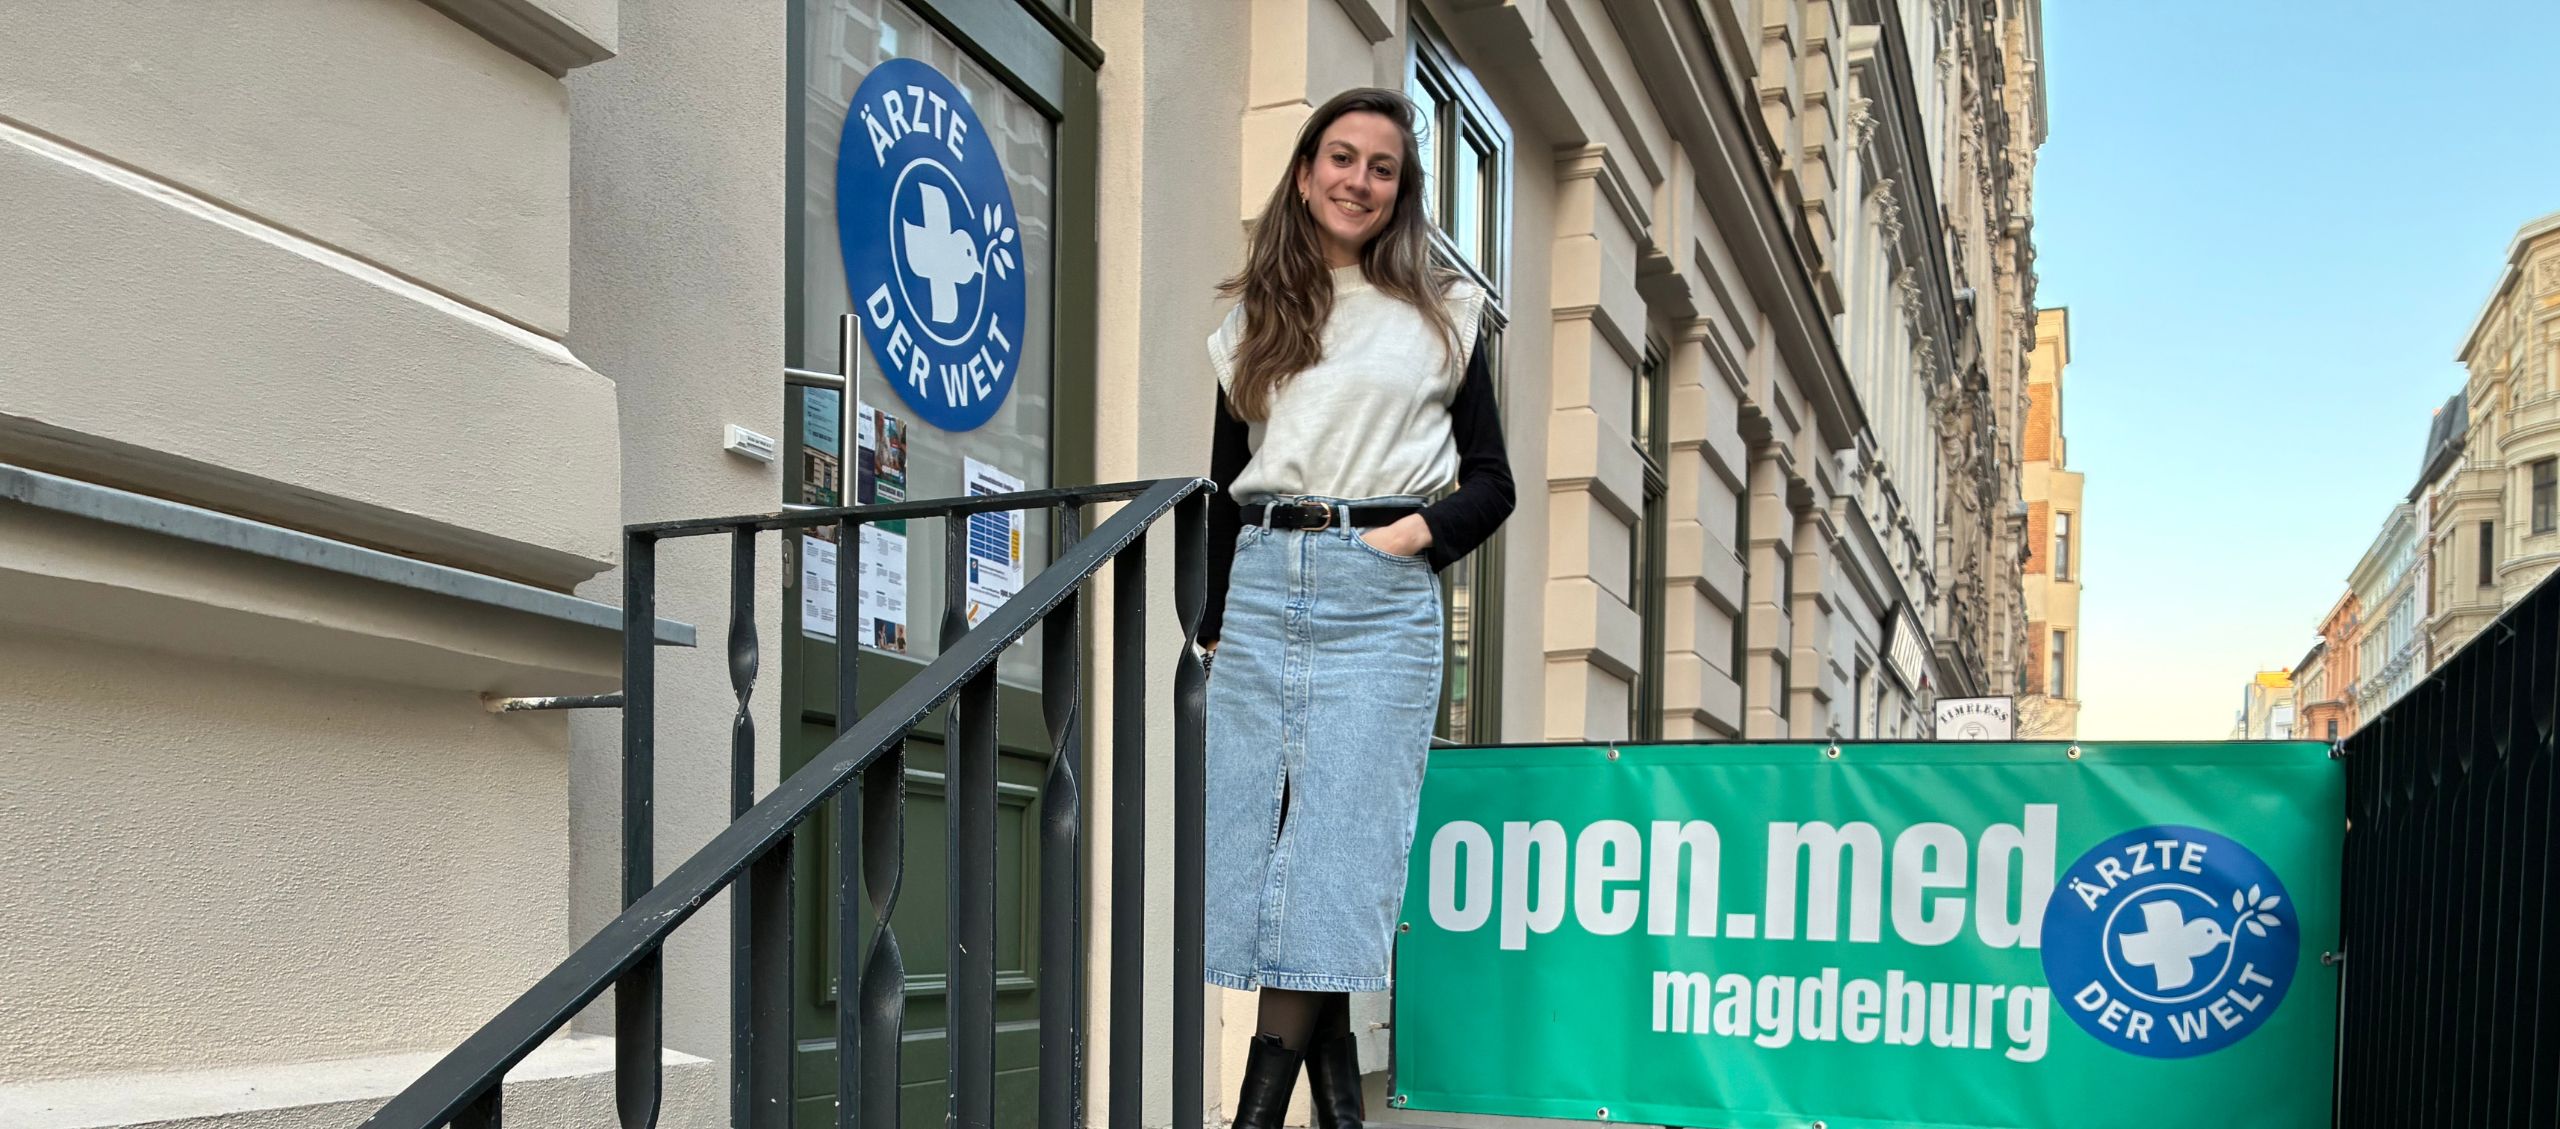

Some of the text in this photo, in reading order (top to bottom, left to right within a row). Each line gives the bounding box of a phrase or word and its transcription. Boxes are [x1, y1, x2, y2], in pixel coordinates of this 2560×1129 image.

[860, 84, 968, 167] ÄRZTE
[866, 282, 1011, 408] DER WELT
[1938, 703, 2009, 725] TIMELESS
[1428, 804, 2058, 951] open.med
[2068, 840, 2208, 912] ÄRZTE
[1651, 967, 2051, 1063] magdeburg
[2073, 962, 2274, 1044] DER WELT
